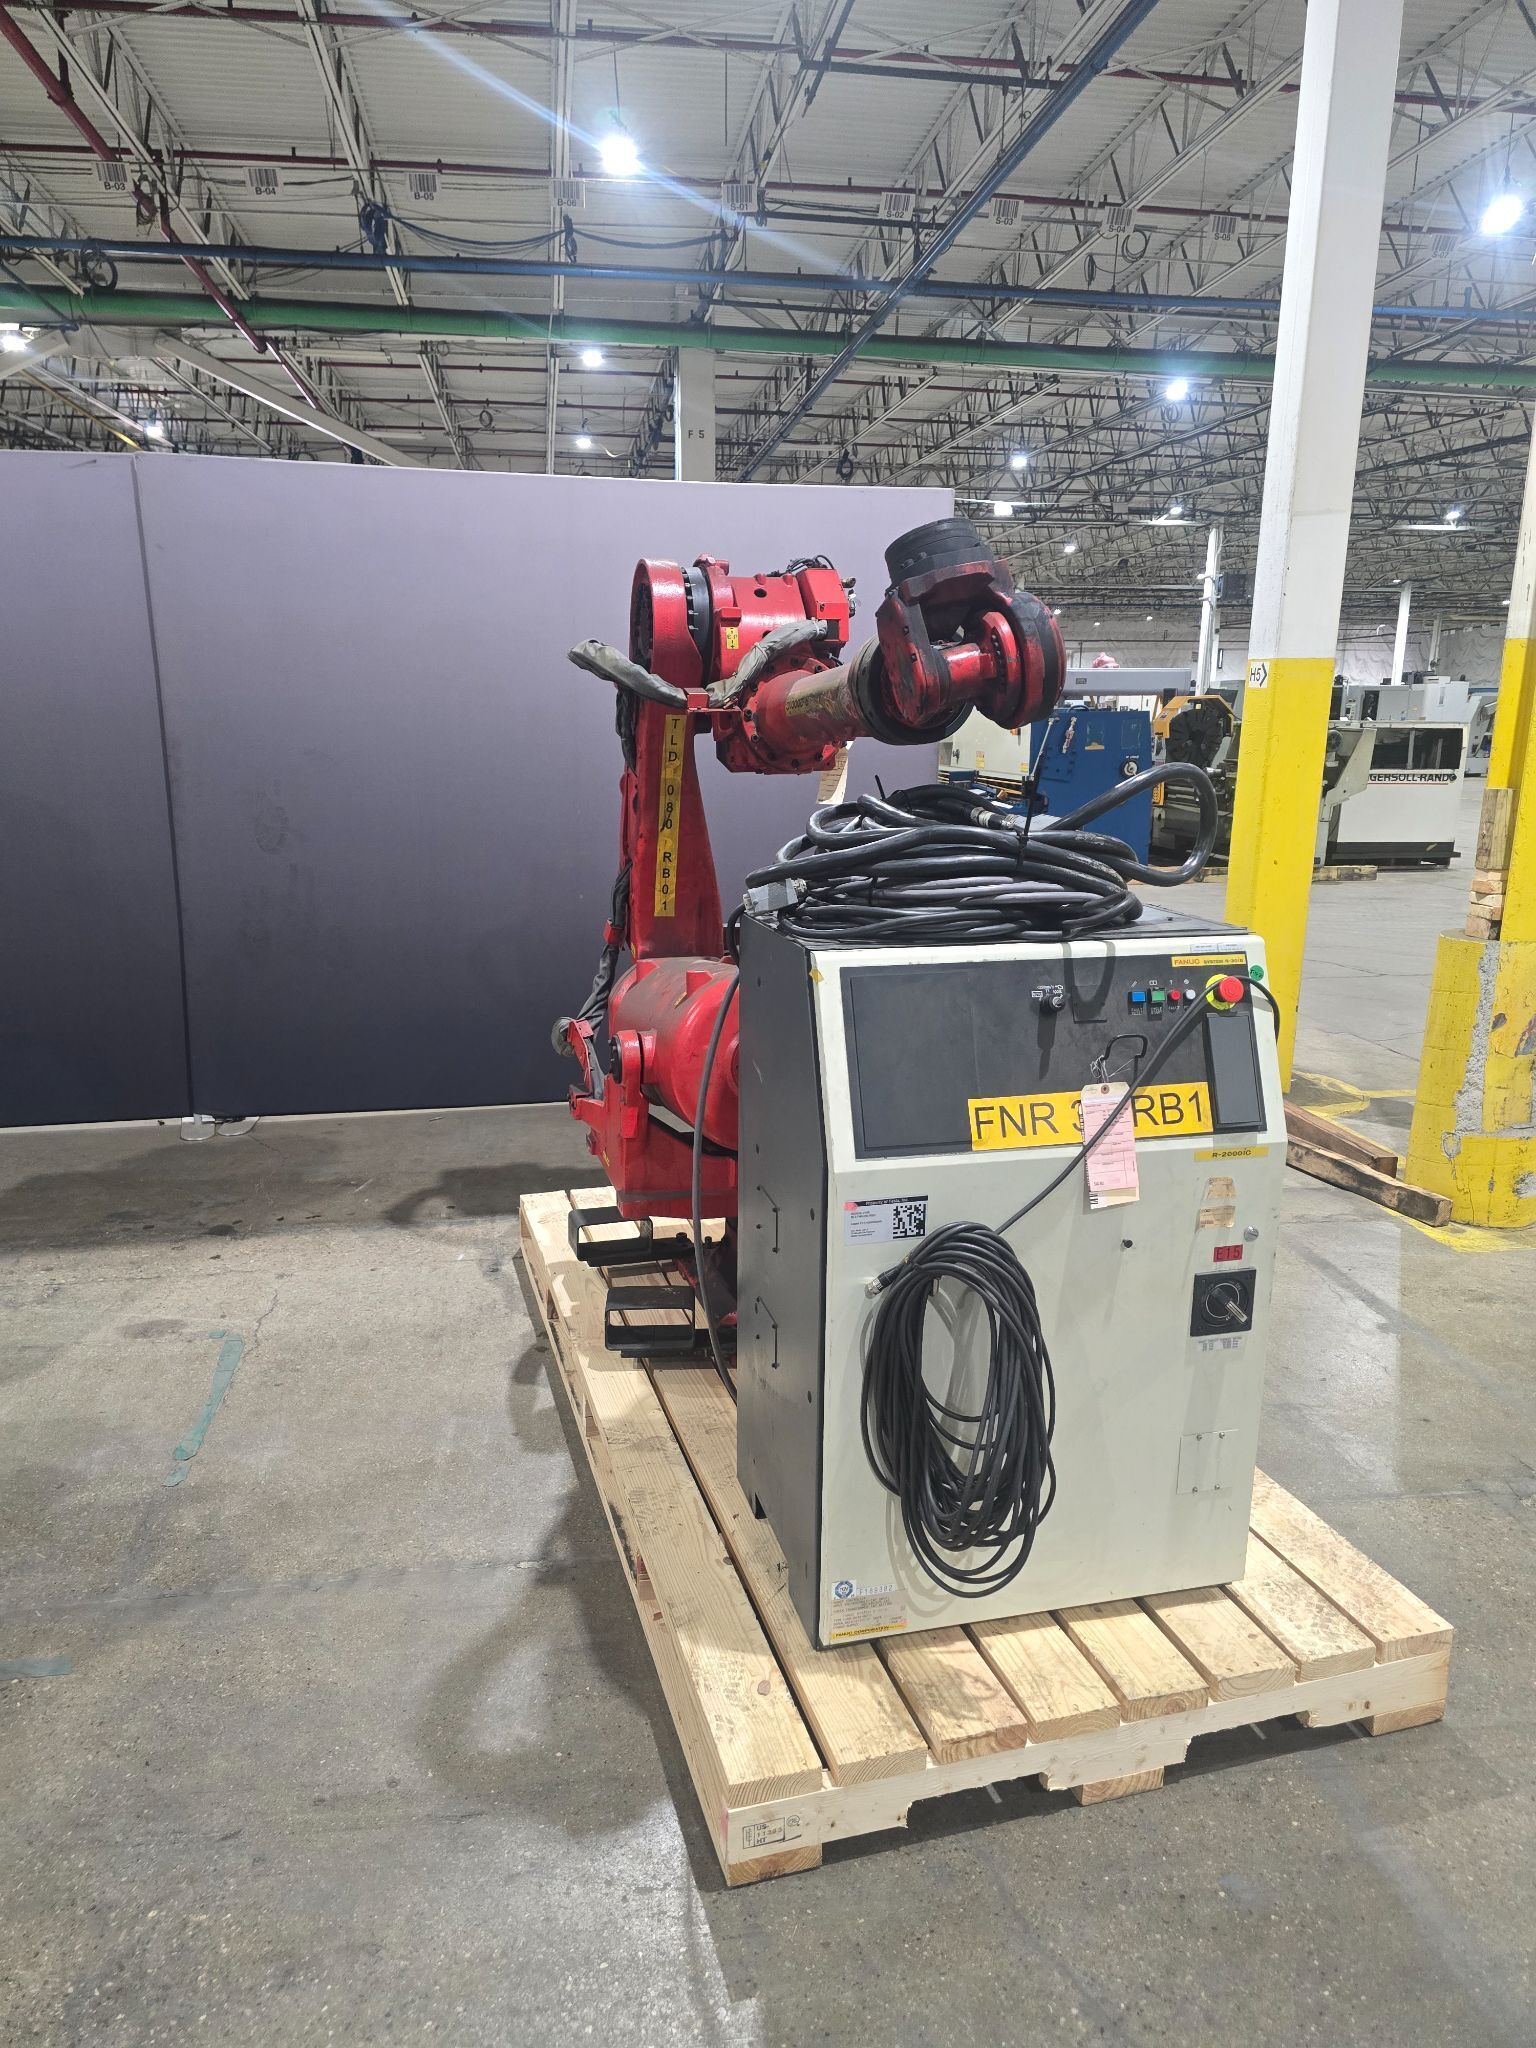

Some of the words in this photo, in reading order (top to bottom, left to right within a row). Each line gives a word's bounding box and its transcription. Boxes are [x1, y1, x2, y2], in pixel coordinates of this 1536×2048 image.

[104, 181, 126, 191] B-03
[255, 186, 276, 196] B-04
[414, 191, 435, 201] B-05
[557, 198, 577, 207] B-06
[730, 203, 749, 212] S-01
[886, 210, 905, 219] S-02
[995, 217, 1014, 226] S-03
[1108, 225, 1127, 234] S-04
[1214, 232, 1232, 241] S-05
[1250, 666, 1262, 682] H5
[1174, 957, 1200, 965] FANUC
[974, 1101, 1060, 1140] FNR
[1132, 1090, 1203, 1128] RB1
